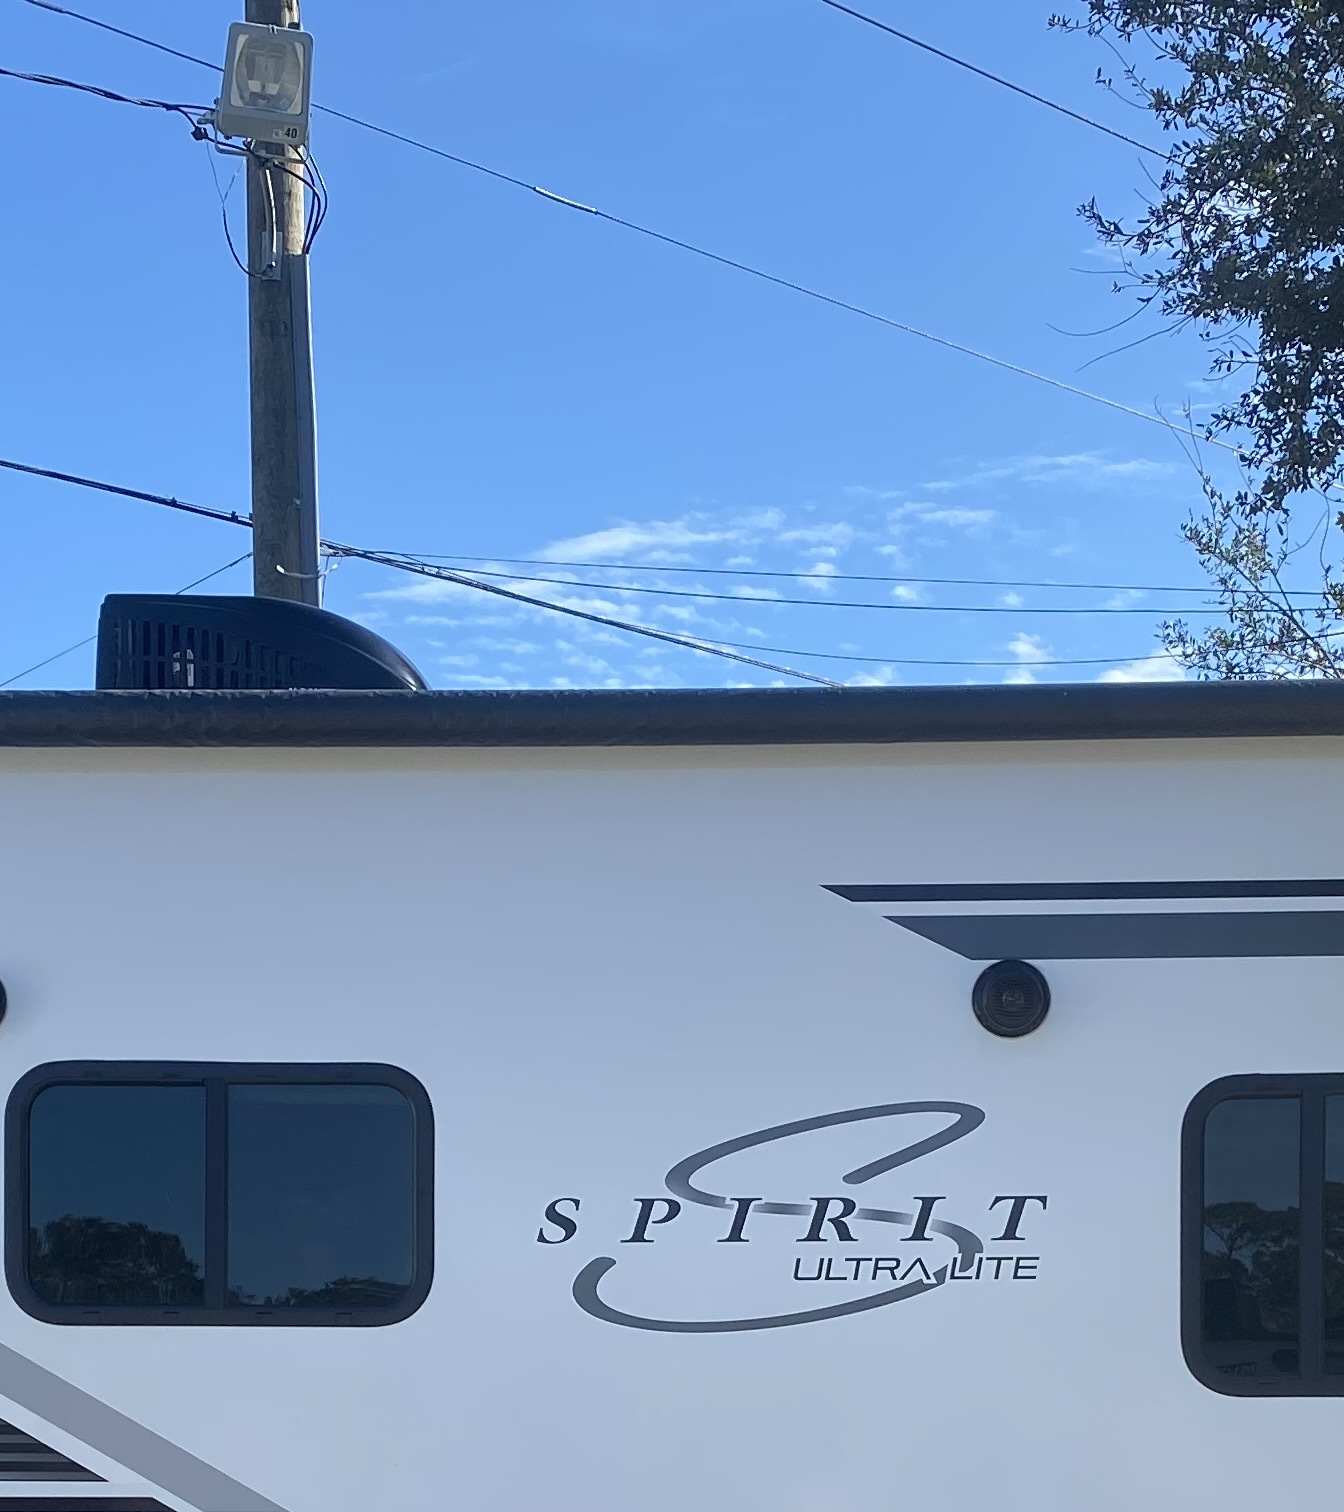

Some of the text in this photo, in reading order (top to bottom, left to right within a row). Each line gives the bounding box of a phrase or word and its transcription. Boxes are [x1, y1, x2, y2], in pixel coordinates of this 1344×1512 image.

[285, 128, 297, 138] 40
[537, 1196, 1047, 1244] SPIRIT
[793, 1256, 1040, 1281] ULTRA LITE
